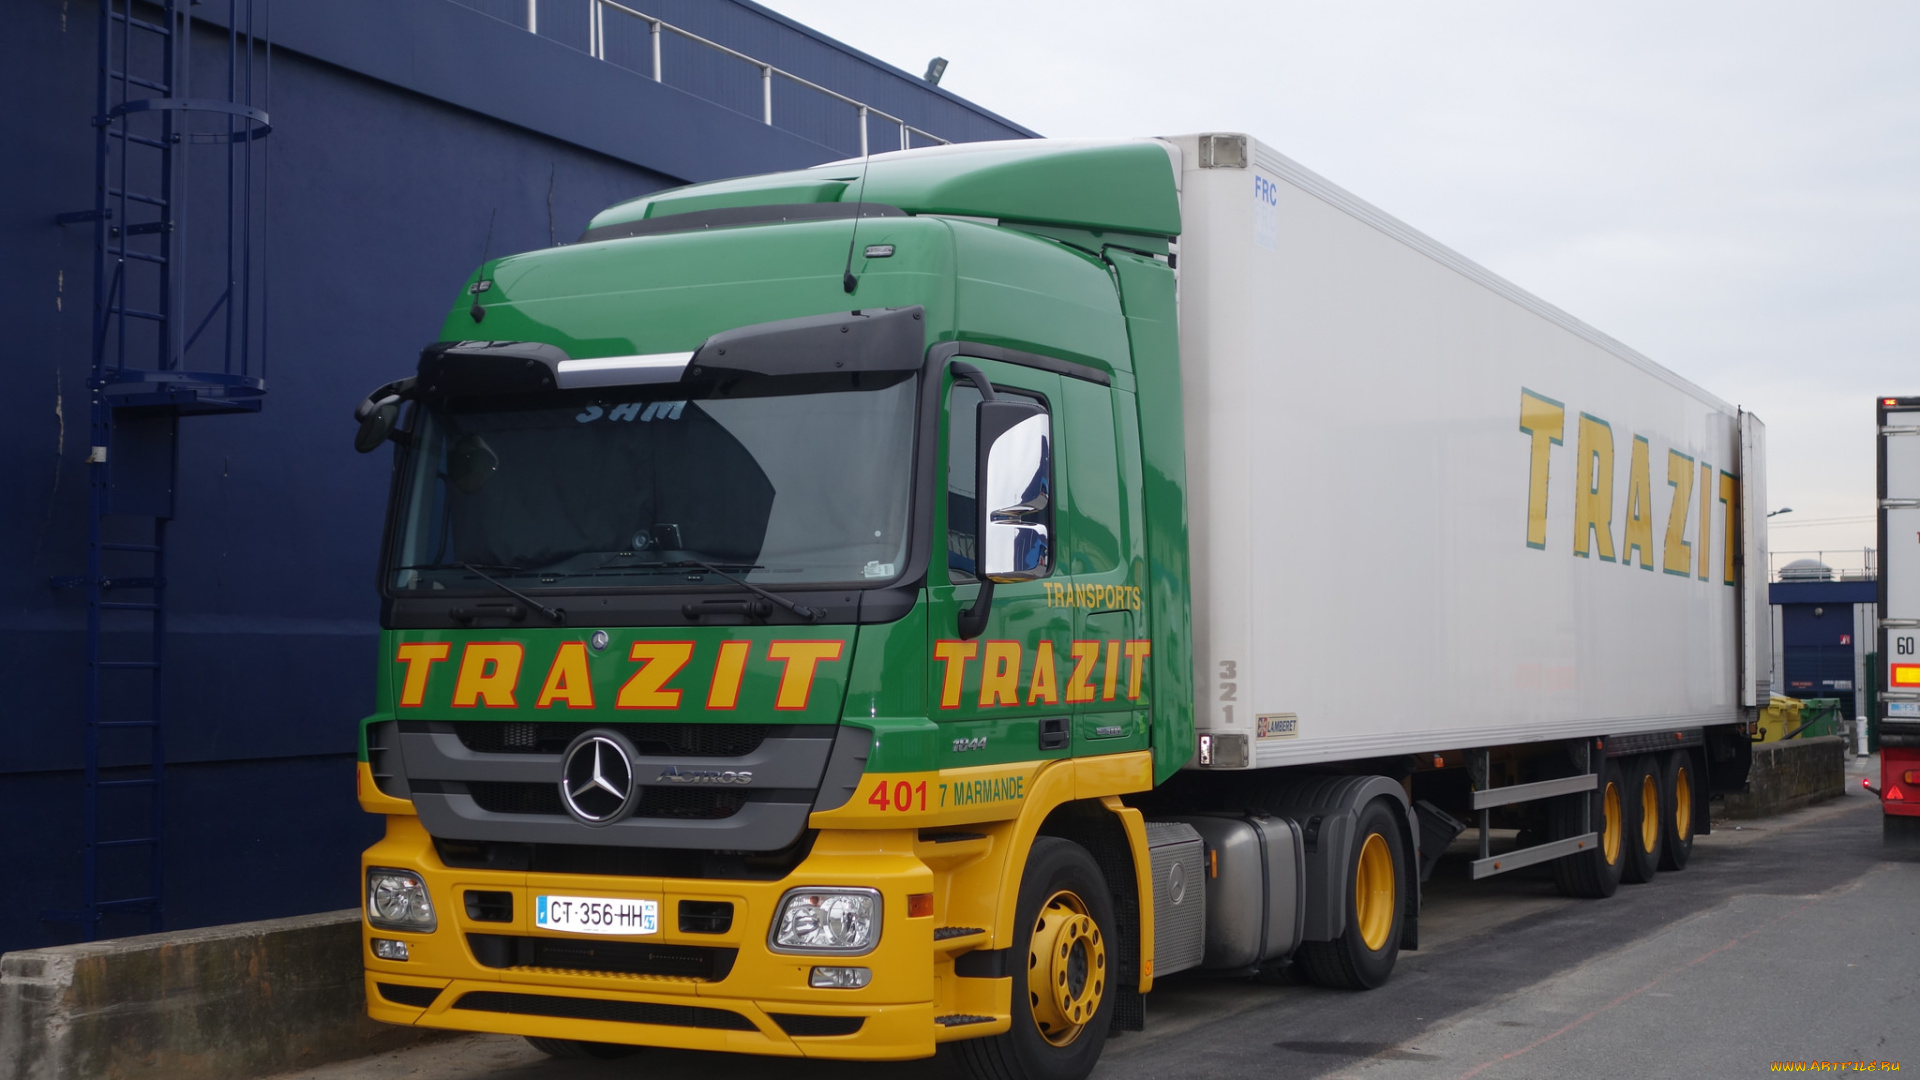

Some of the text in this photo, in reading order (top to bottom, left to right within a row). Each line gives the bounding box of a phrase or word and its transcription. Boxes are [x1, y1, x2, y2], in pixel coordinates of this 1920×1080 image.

[1255, 175, 1277, 206] FRC
[1519, 386, 1741, 587] TRAZIT
[1043, 582, 1141, 611] TRANSPORTS
[1897, 636, 1914, 655] 60
[397, 641, 844, 710] TRAZIT
[933, 639, 1151, 710] TRAZIT
[1267, 720, 1297, 733] LAMBERET
[868, 780, 927, 811] 401
[953, 776, 1024, 807] MARMANDE
